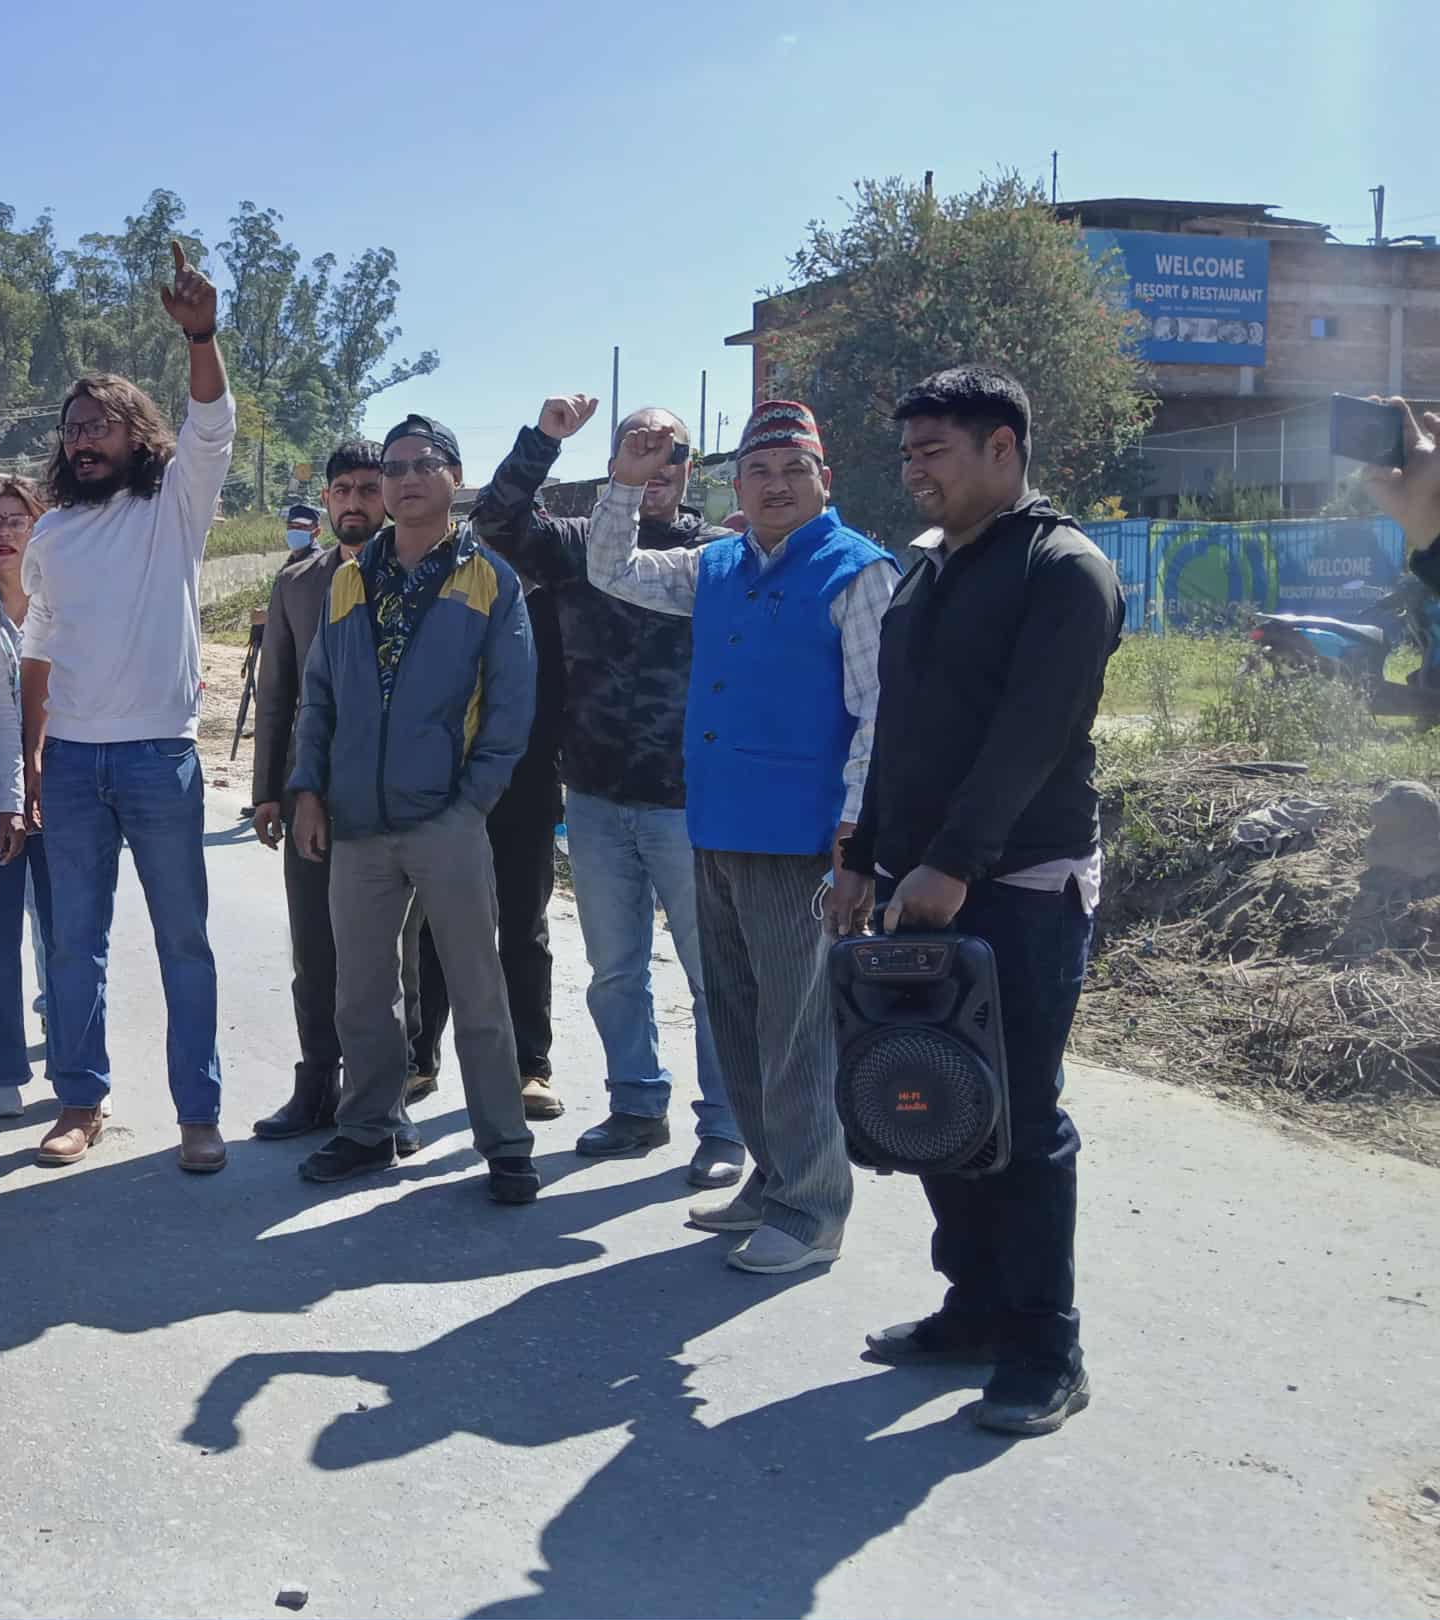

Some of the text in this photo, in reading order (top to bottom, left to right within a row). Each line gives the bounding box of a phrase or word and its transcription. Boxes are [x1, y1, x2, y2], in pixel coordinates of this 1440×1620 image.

[1155, 253, 1246, 279] WELCOME
[1135, 282, 1179, 298] RESORT
[1191, 286, 1264, 303] RESTAURANT
[1306, 557, 1372, 577] WELCOME
